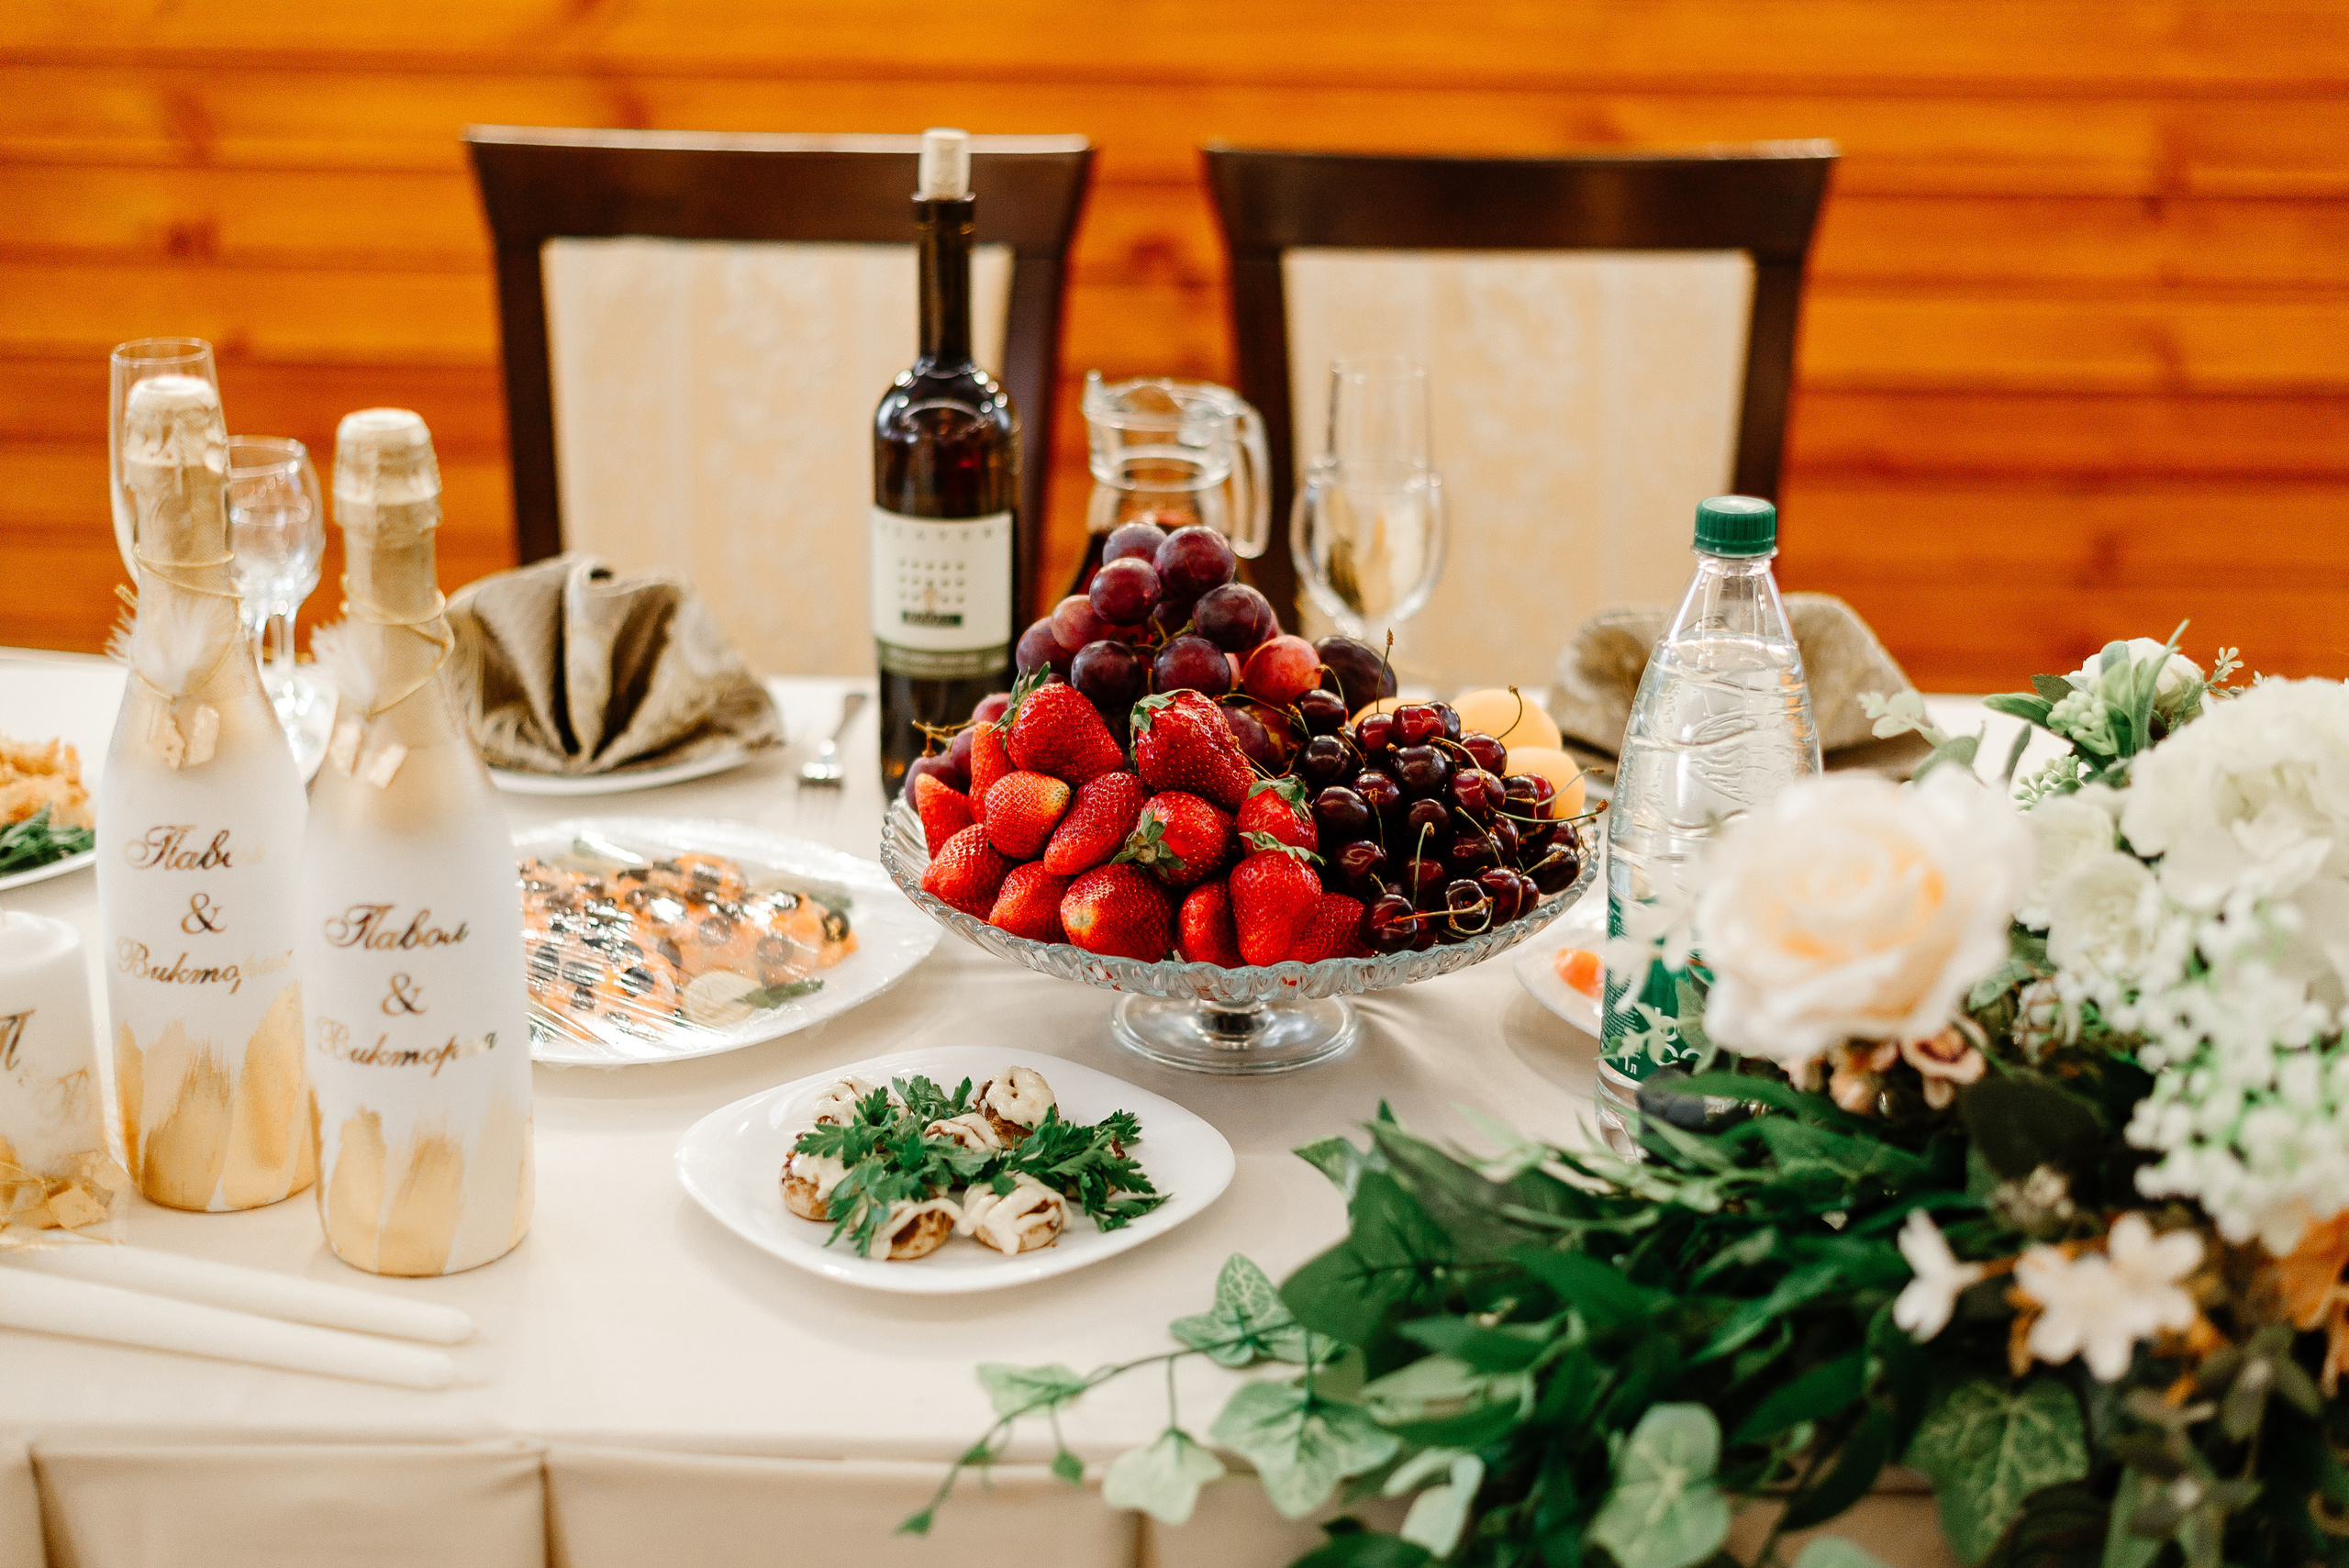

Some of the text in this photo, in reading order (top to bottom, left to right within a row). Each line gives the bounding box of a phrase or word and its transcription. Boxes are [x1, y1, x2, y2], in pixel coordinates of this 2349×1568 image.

[181, 893, 228, 936] &
[382, 973, 430, 1017] &
[317, 1015, 499, 1079] Викторя
